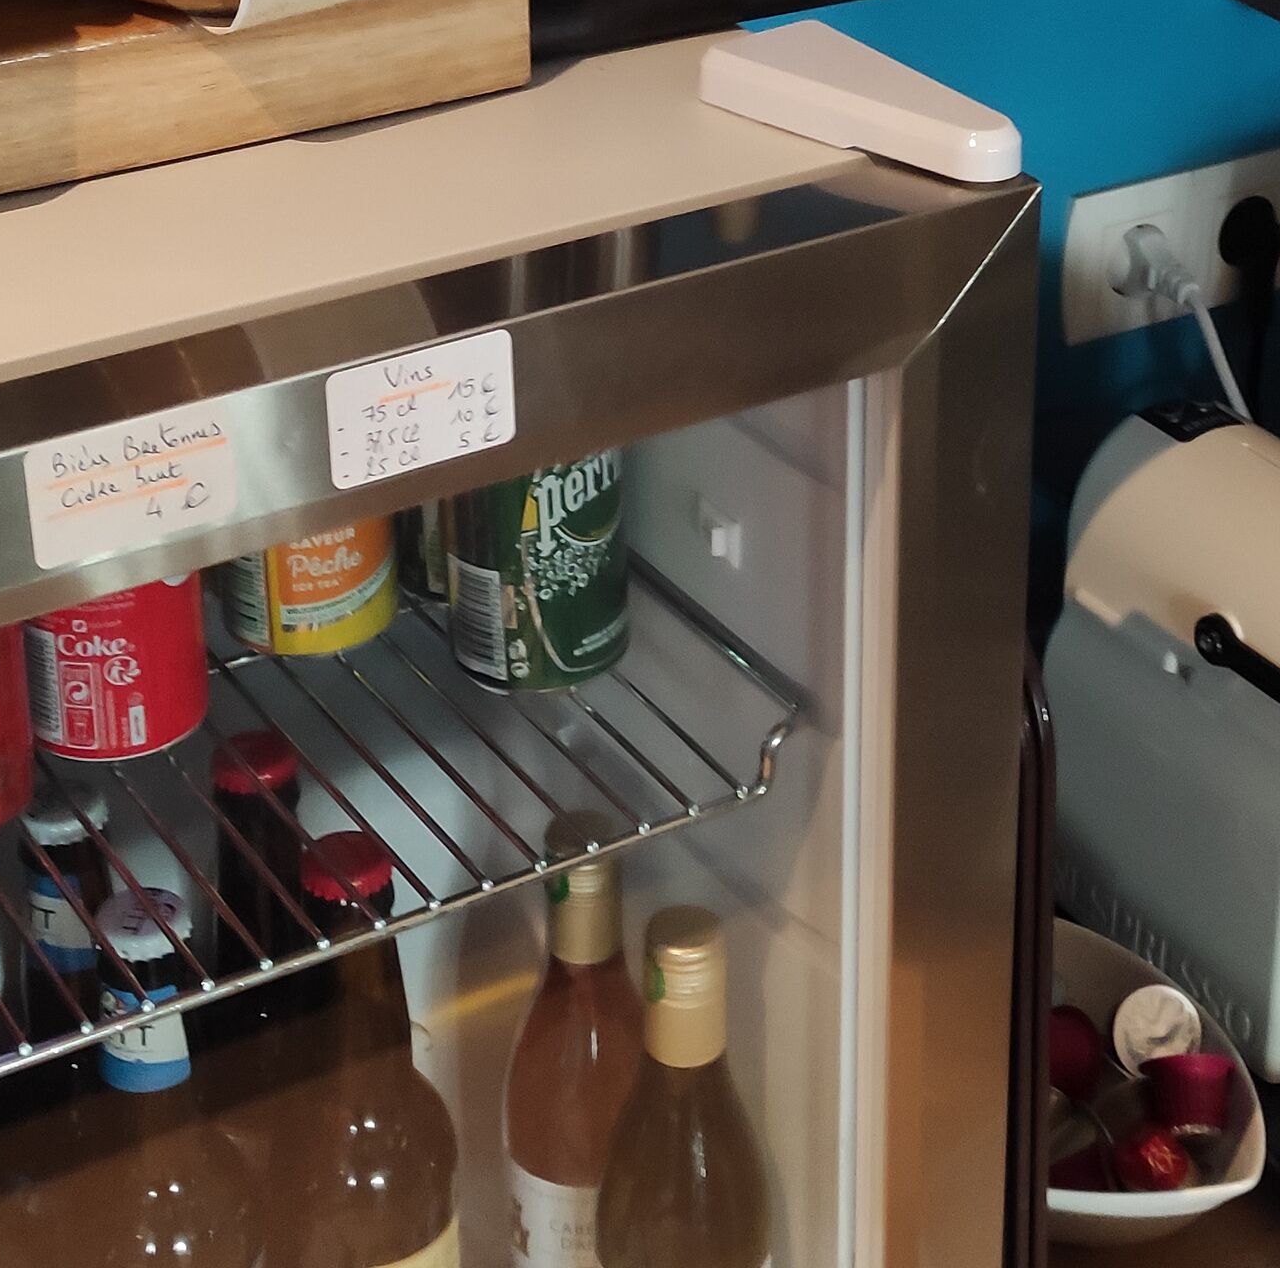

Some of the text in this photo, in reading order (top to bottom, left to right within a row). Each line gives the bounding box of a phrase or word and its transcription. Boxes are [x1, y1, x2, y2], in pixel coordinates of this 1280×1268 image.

[383, 363, 434, 388] Vins
[146, 497, 162, 518] 4
[57, 634, 128, 657] Coke
